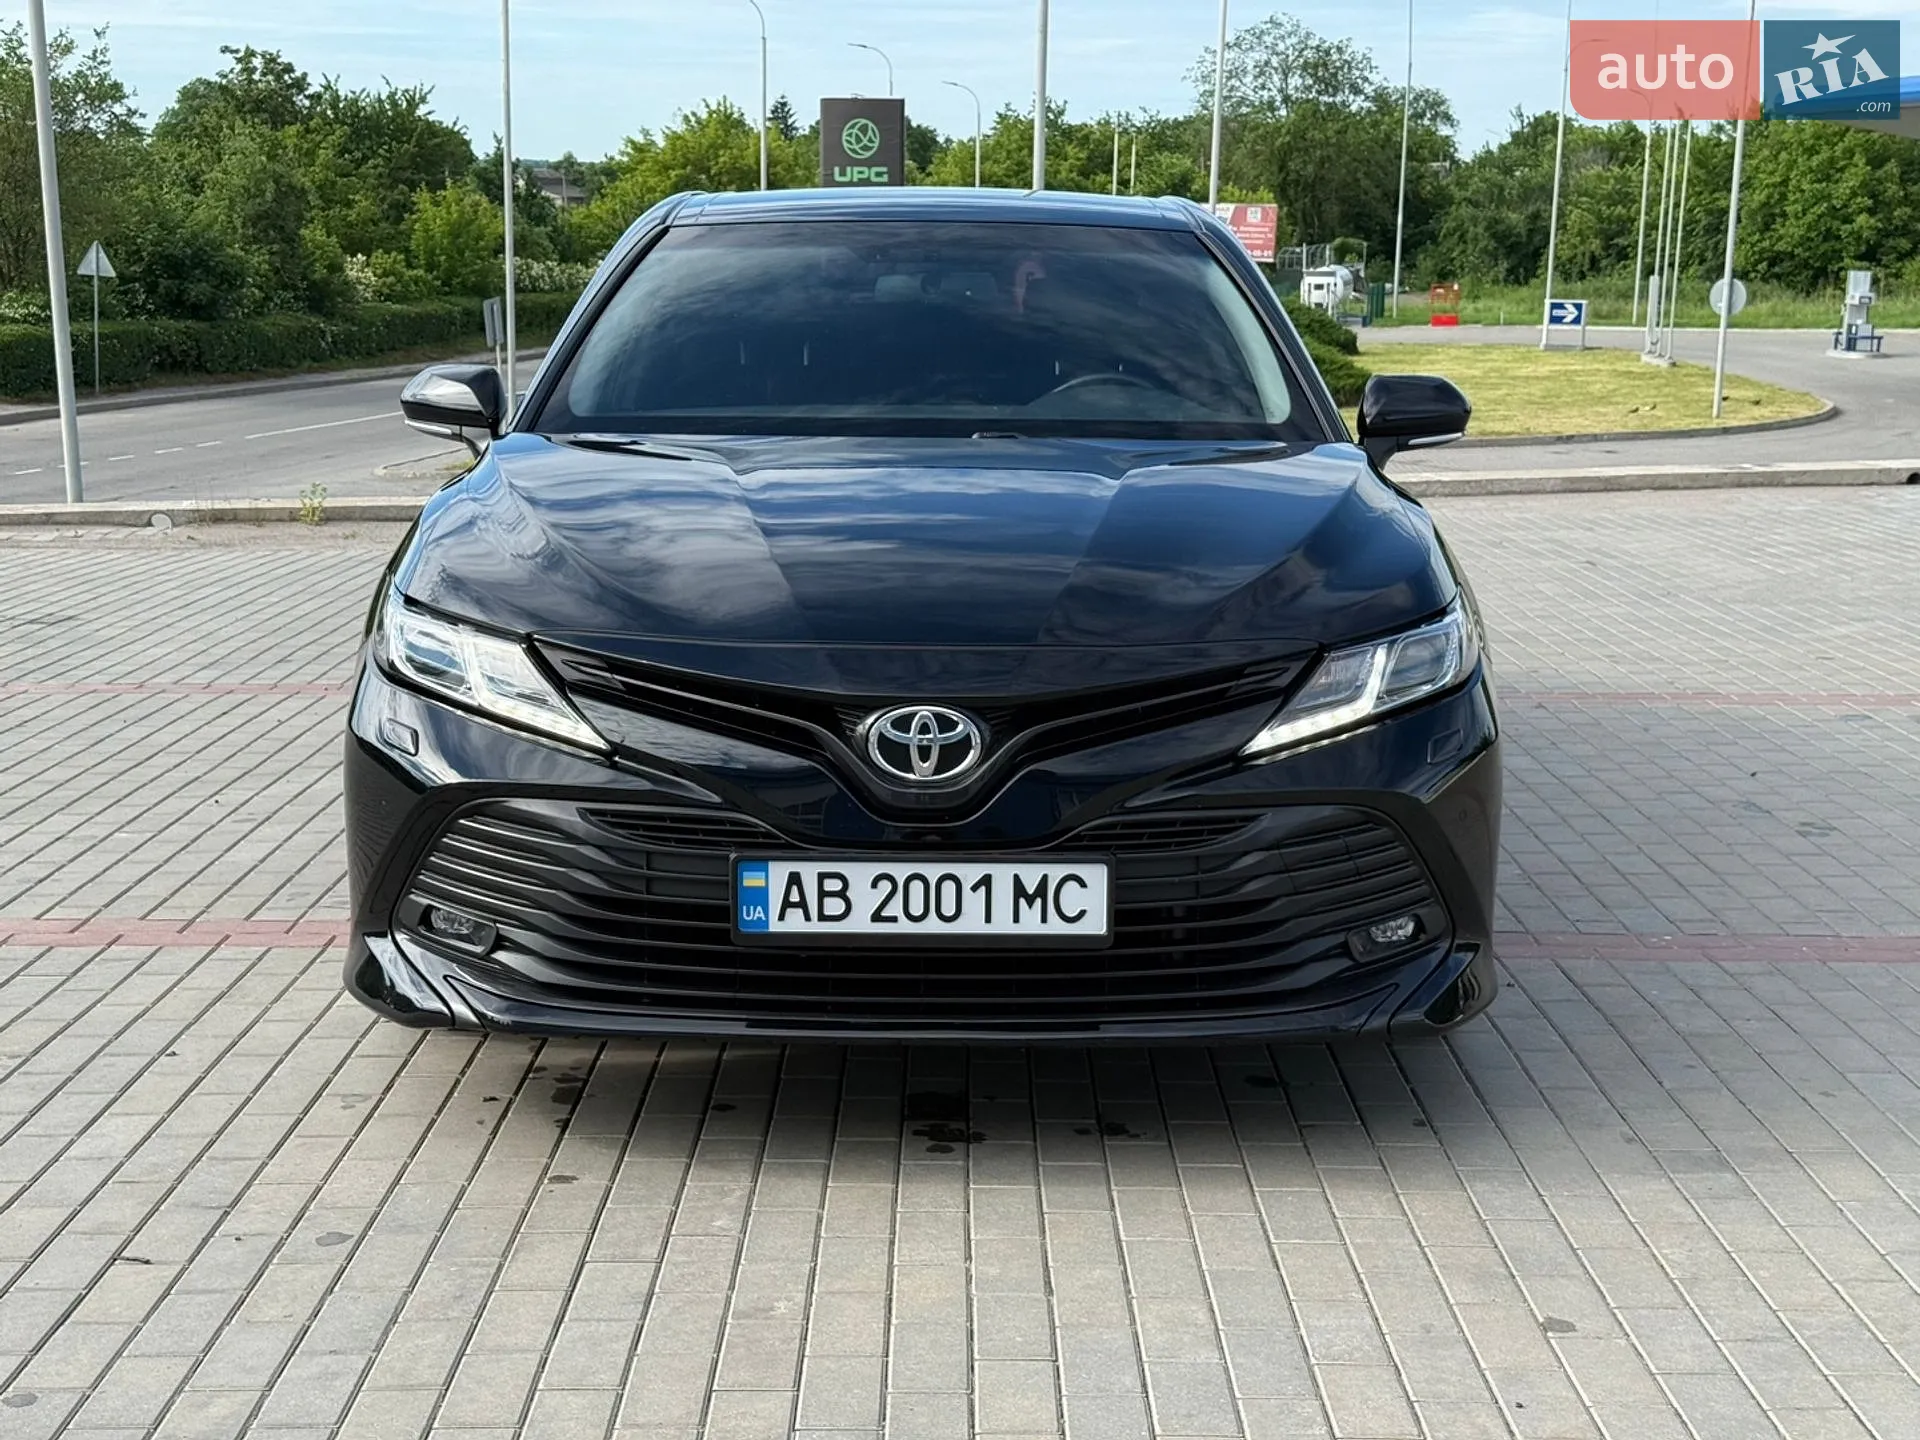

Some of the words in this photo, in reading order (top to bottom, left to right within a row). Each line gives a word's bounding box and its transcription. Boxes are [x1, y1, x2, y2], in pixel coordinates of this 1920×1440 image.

[833, 166, 889, 183] UPG
[777, 870, 853, 923] AB
[869, 871, 993, 924] 2001
[1012, 872, 1088, 925] MC
[742, 905, 767, 921] UA
